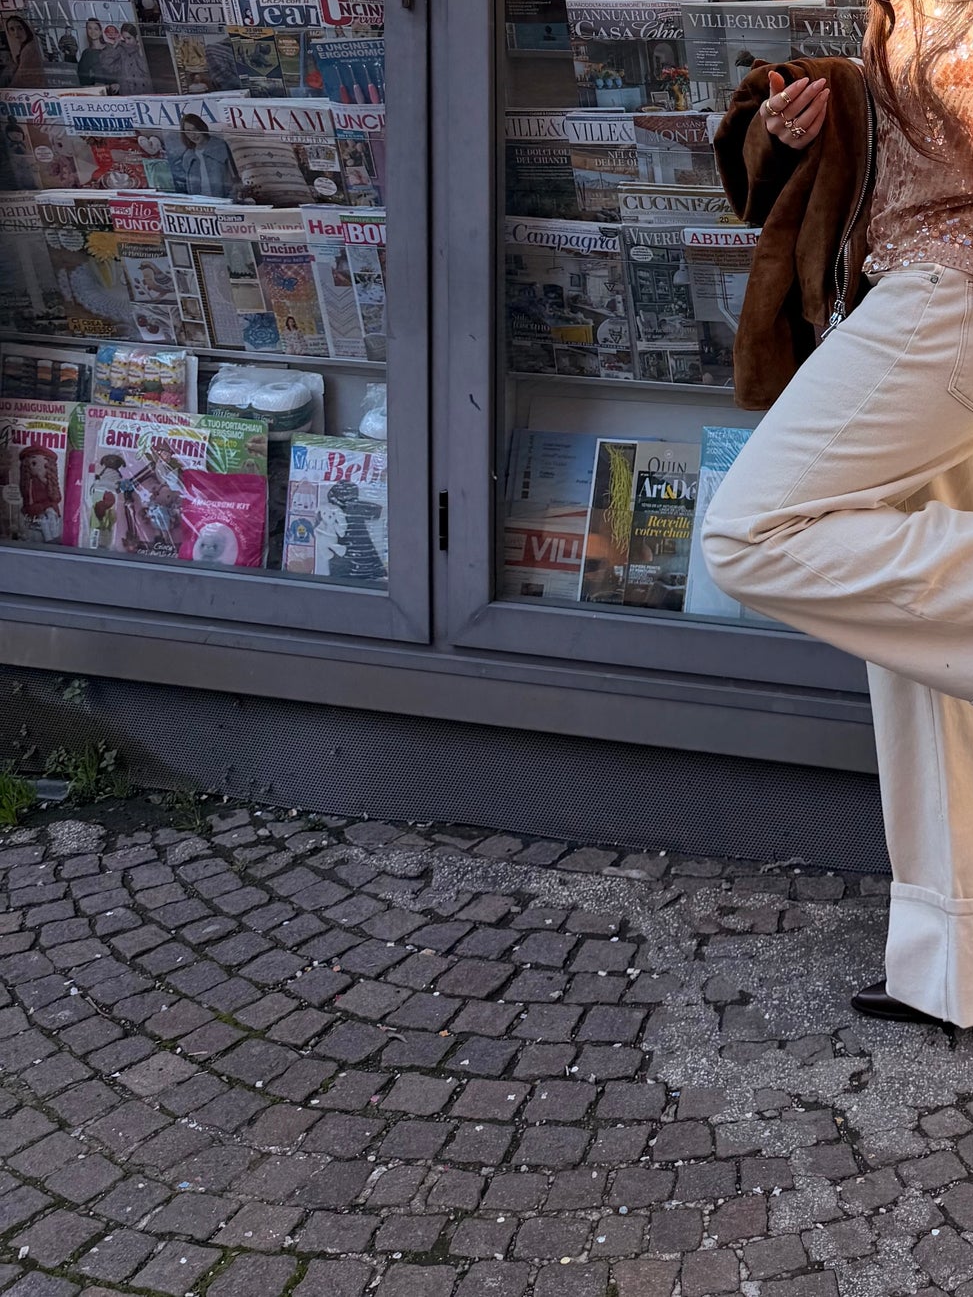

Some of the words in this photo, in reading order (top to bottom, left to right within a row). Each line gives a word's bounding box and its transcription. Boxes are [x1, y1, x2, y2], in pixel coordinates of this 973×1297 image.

[575, 21, 633, 40] CASA
[229, 107, 327, 133] RAKAM
[115, 217, 161, 231] PUNTO
[220, 222, 257, 234] Lavori
